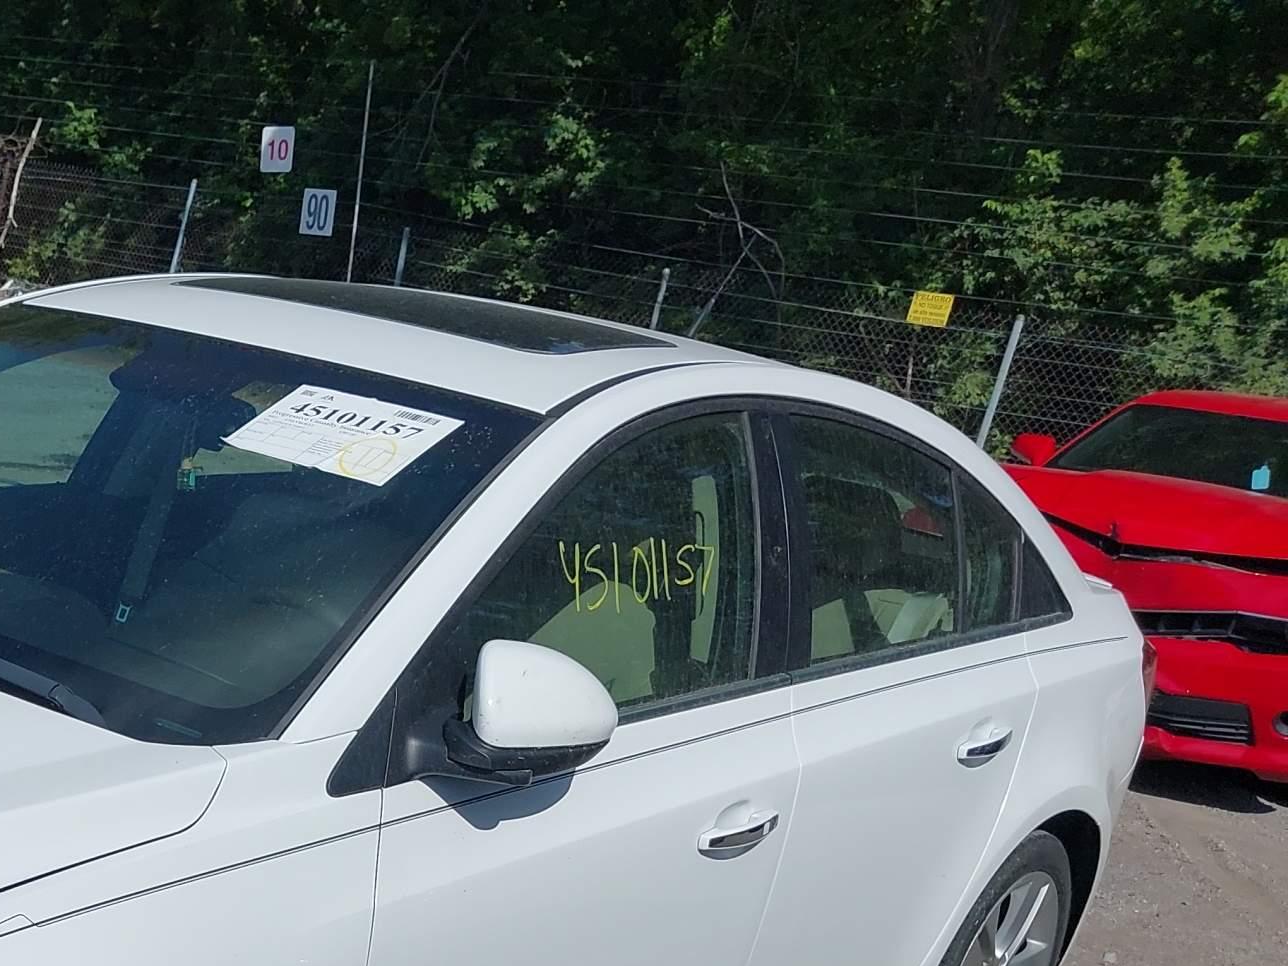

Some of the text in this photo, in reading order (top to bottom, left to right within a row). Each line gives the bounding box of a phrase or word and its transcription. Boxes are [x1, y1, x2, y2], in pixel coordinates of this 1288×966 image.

[268, 139, 289, 161] 10
[305, 193, 330, 231] 90
[289, 402, 424, 439] 45101157
